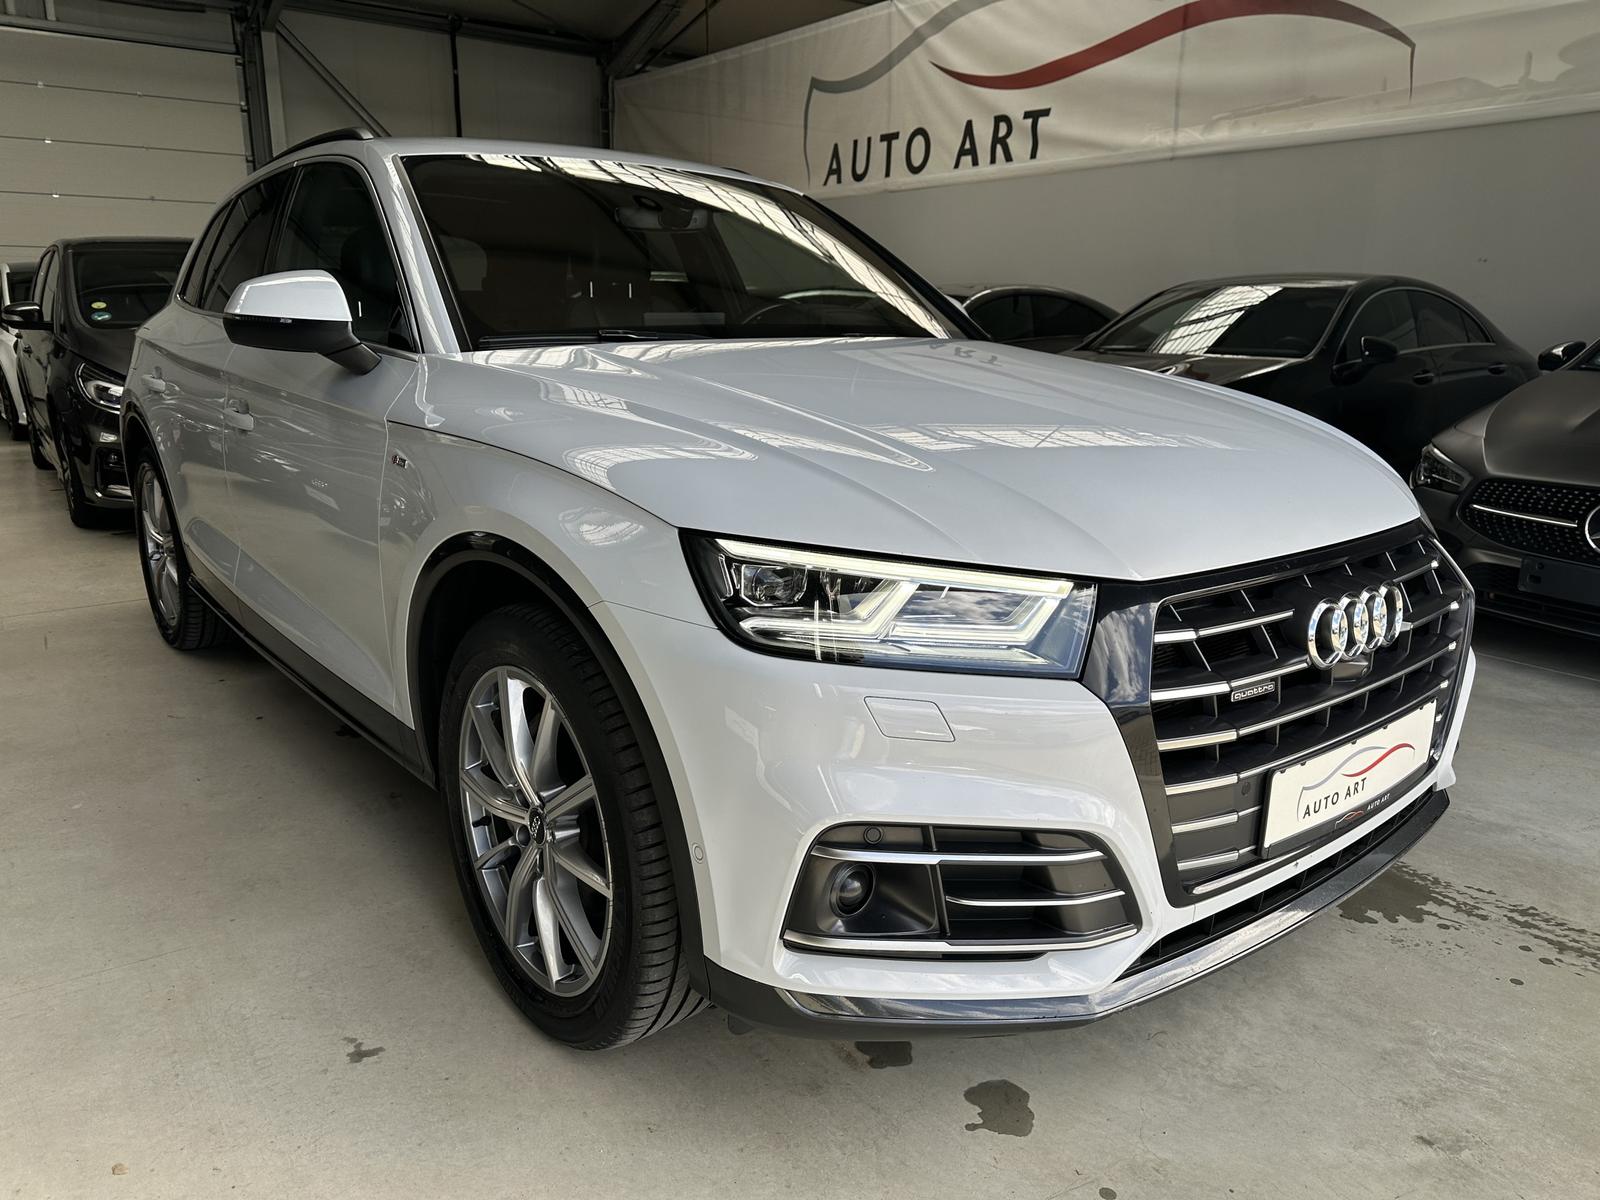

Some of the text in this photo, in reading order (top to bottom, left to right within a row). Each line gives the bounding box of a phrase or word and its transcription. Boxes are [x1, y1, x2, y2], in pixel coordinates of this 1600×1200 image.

[823, 107, 1052, 186] AUTO ART
[1234, 684, 1274, 701] quattro
[1302, 777, 1367, 819] AUTO ART
[1366, 793, 1391, 811] AUTO ART
